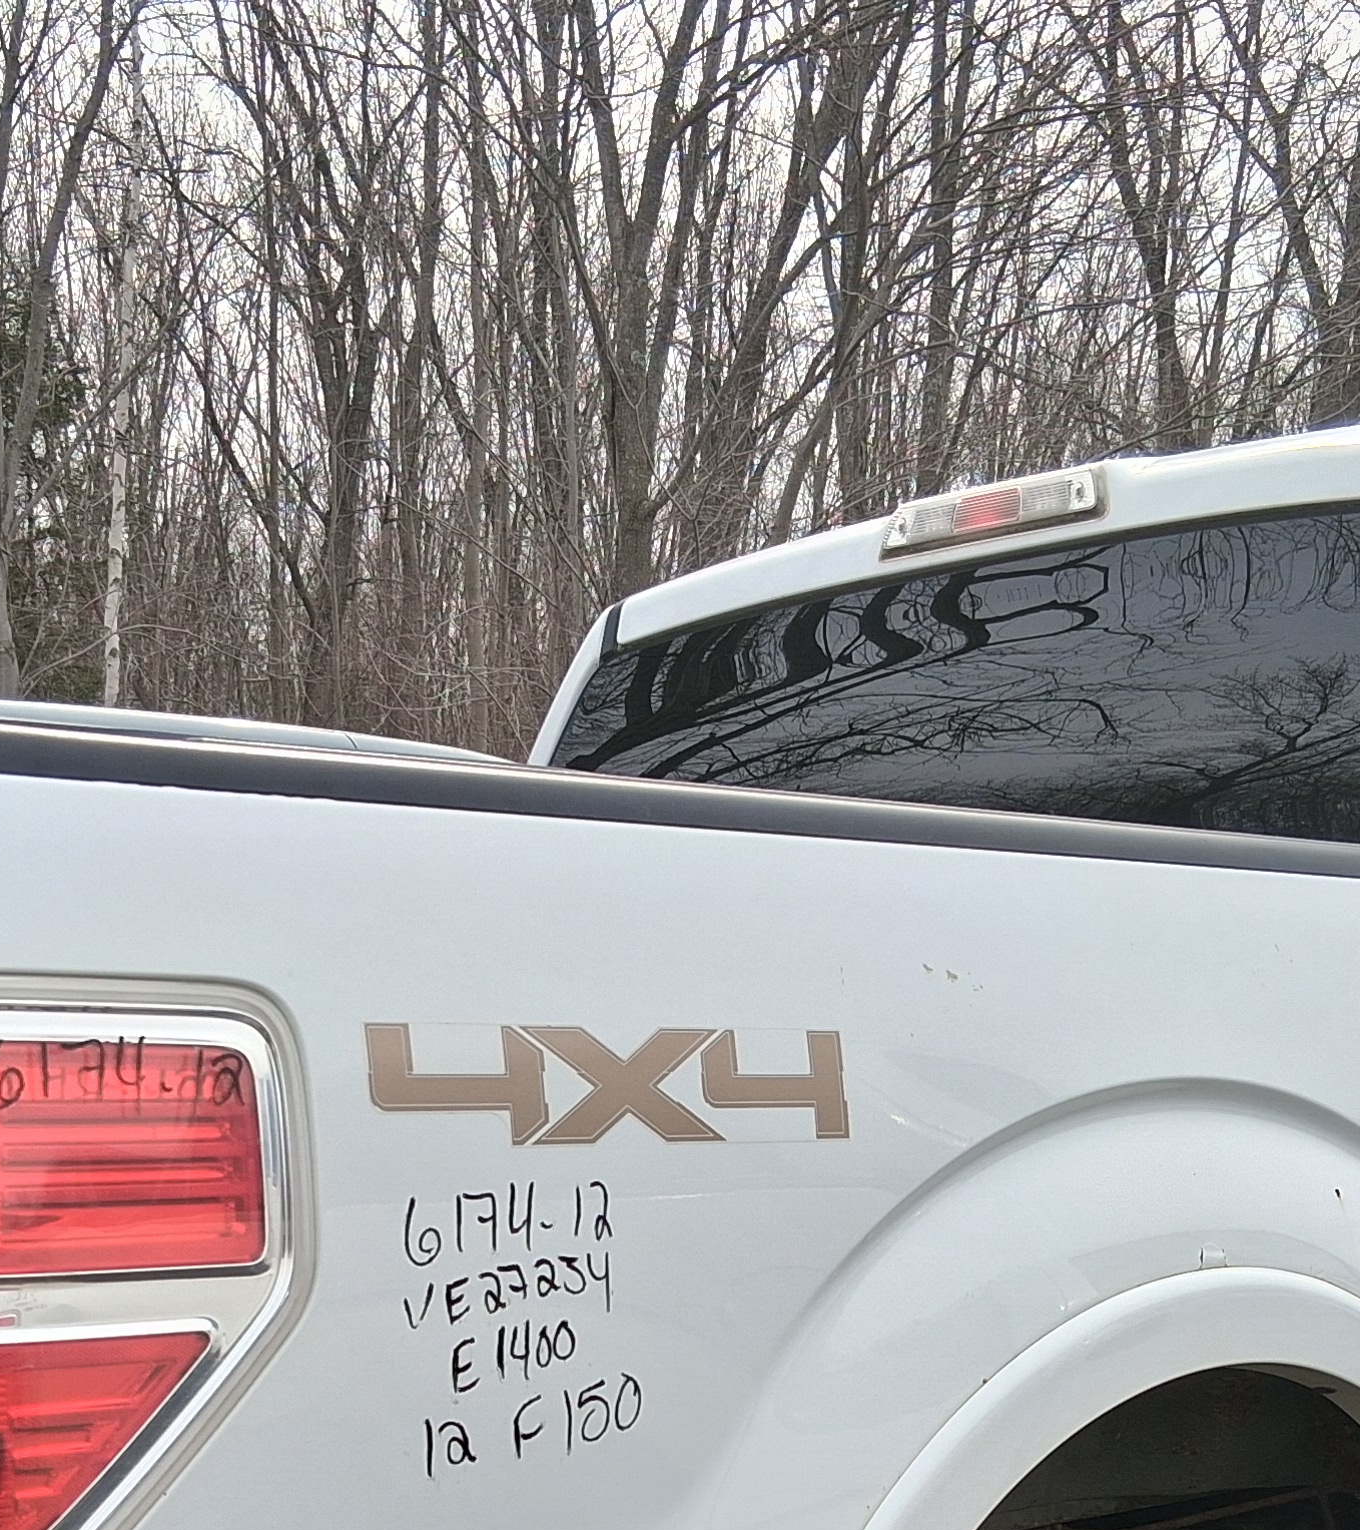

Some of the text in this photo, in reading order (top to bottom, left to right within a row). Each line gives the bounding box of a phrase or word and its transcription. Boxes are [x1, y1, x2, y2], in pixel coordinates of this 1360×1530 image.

[403, 1180, 614, 1268] 6174-12
[403, 1251, 612, 1331] VE27234
[424, 1417, 478, 1479] 12
